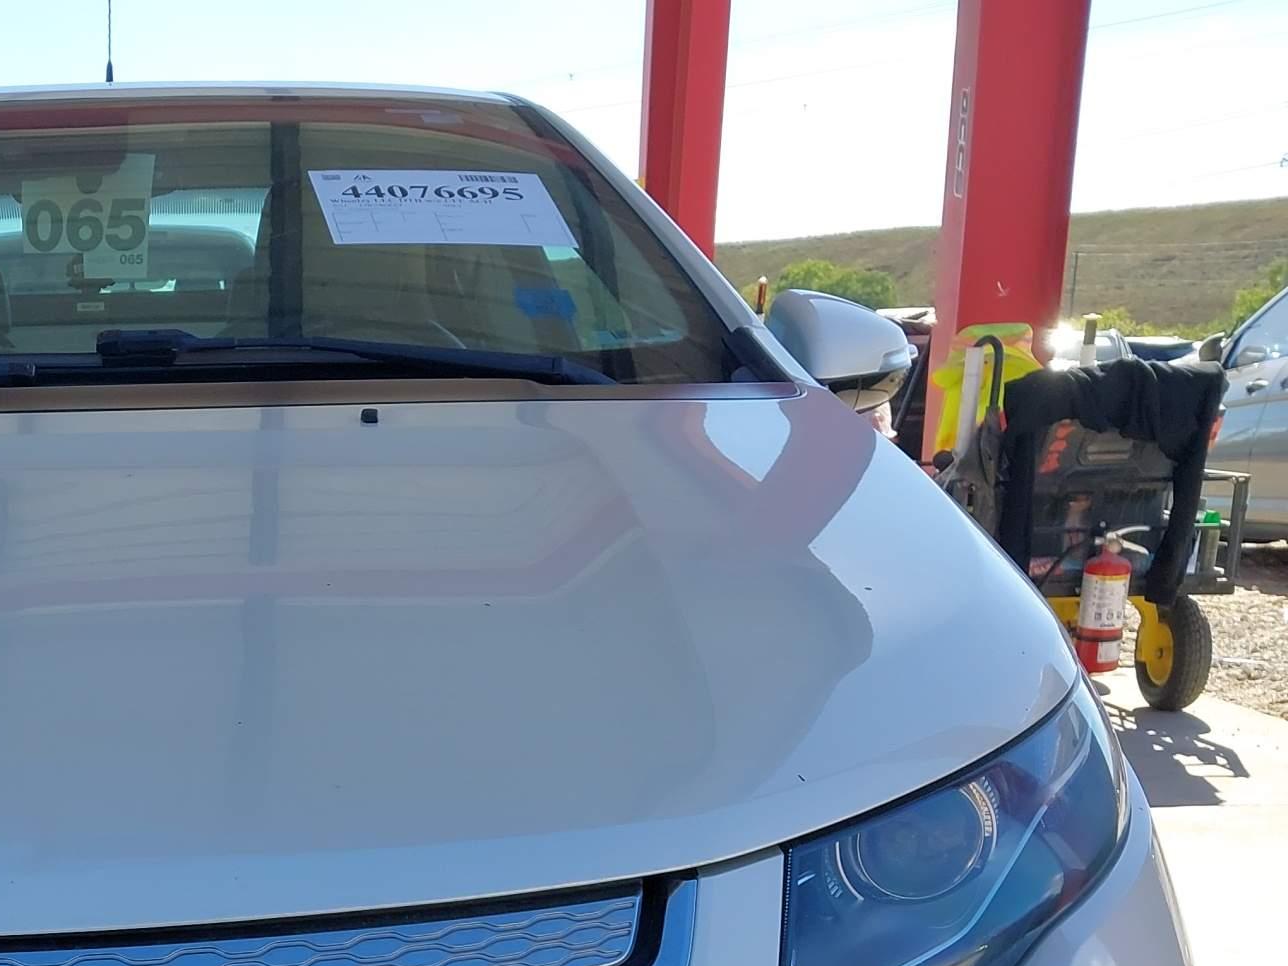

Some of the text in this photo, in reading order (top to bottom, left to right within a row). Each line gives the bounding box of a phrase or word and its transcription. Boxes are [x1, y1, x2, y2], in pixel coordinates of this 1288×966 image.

[340, 183, 525, 202] 44076695
[25, 198, 147, 252] 065
[119, 254, 144, 265] 065
